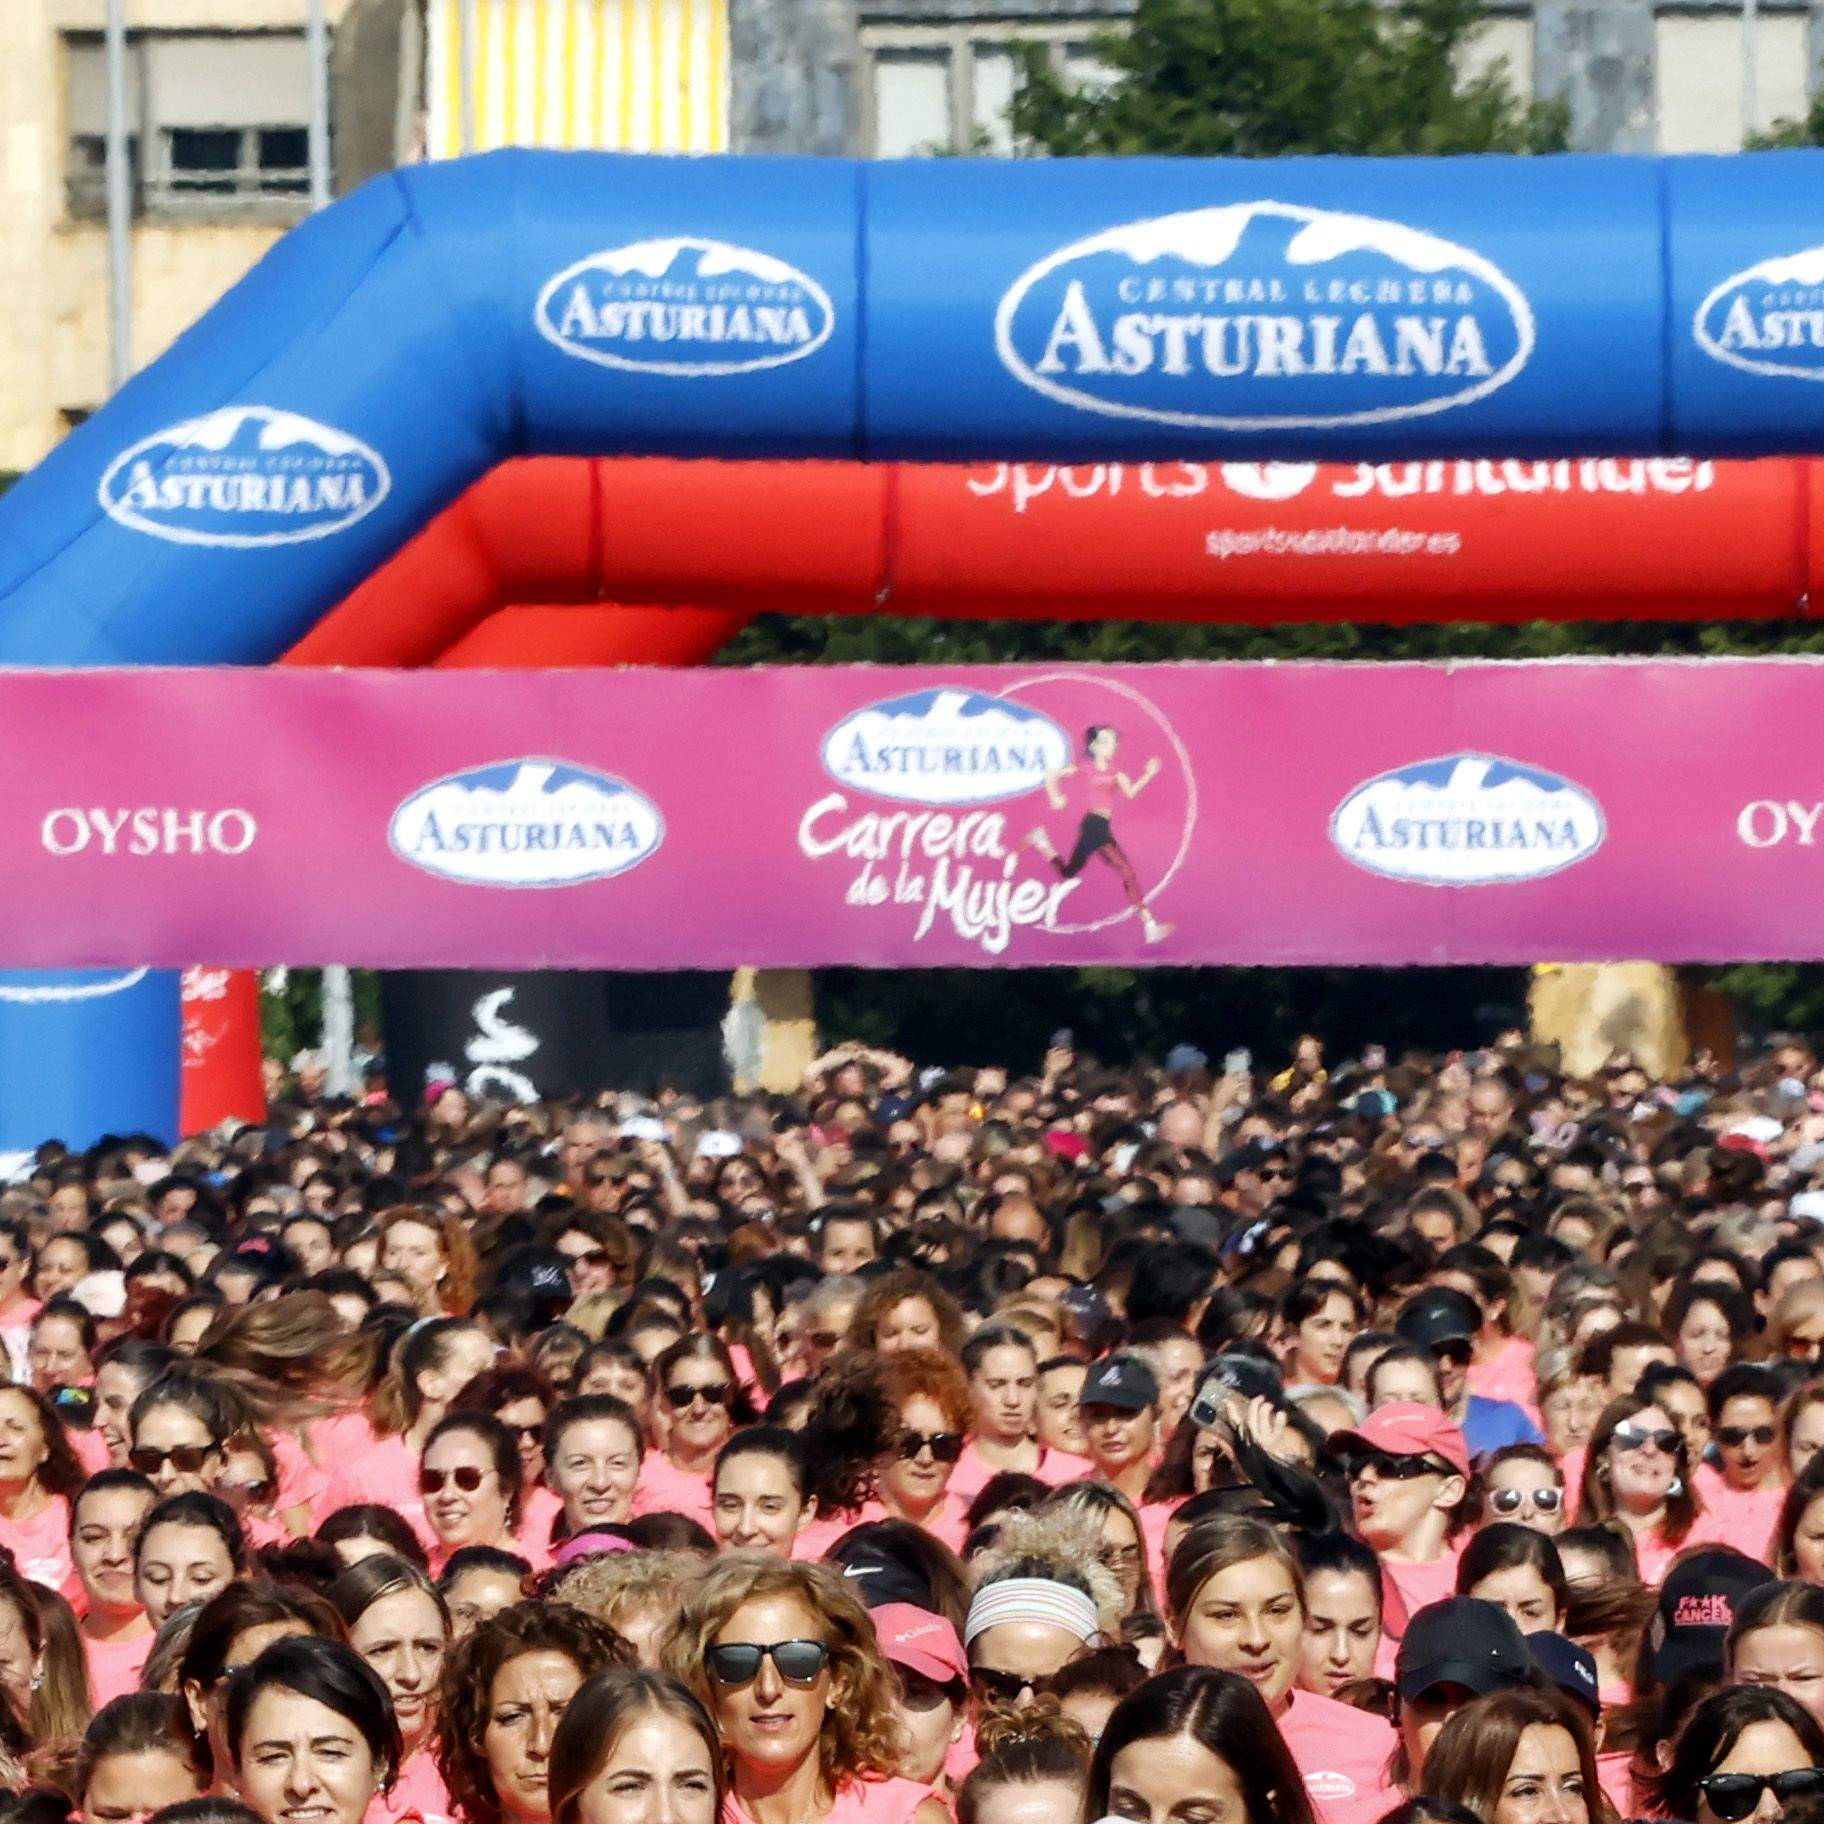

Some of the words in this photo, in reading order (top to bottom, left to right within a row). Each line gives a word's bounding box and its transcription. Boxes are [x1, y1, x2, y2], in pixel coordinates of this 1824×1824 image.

[560, 284, 812, 345] ASTURIANA
[1118, 277, 1289, 303] CENTRAL
[1033, 278, 1495, 378] ASTURIANA
[120, 458, 365, 513] ASTURIANA
[842, 729, 1049, 776] ASTURIANA
[41, 807, 258, 857] OYSHO
[413, 809, 640, 855] ASTURIANA
[798, 793, 1006, 860] Carrera
[1352, 803, 1582, 852] ASTURIANA
[845, 860, 890, 906] de
[893, 859, 926, 904] la
[913, 855, 1082, 955] Mujer
[1673, 1609, 1734, 1623] CANCER
